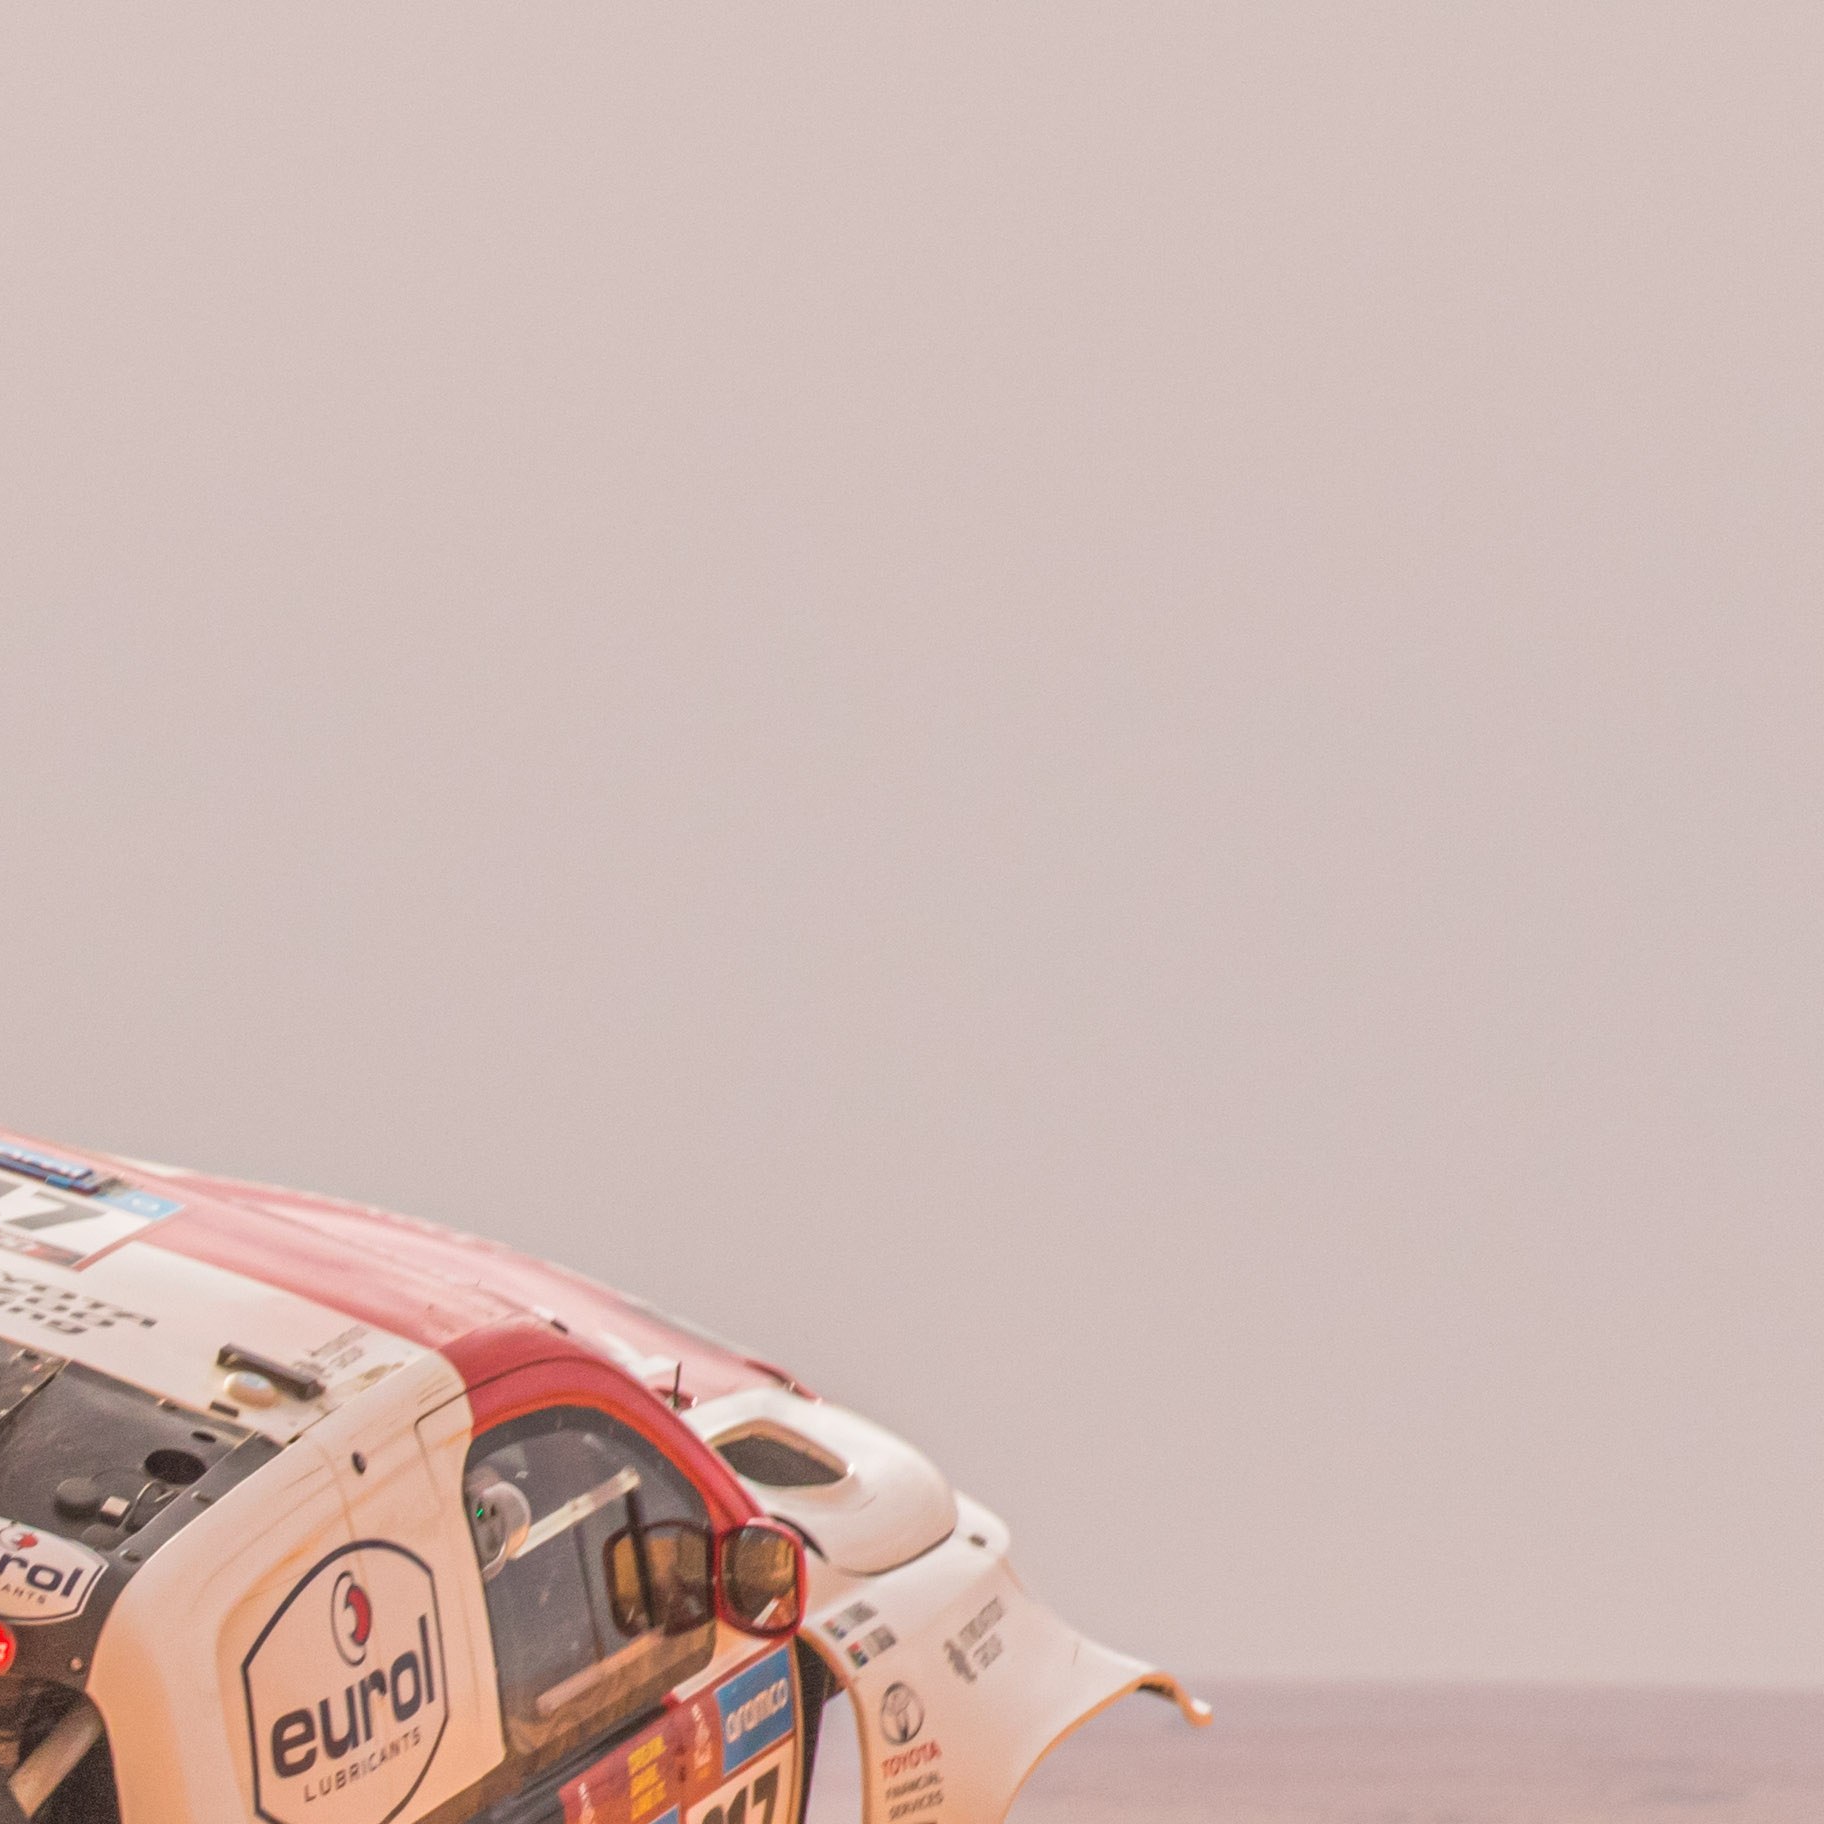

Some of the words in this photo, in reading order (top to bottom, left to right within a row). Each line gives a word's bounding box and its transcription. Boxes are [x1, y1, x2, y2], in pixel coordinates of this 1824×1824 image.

[269, 1612, 437, 1781] eurol
[725, 1672, 790, 1744] aramco
[302, 1725, 423, 1804] LUBRICANTS
[881, 1738, 942, 1779] TOYOTA
